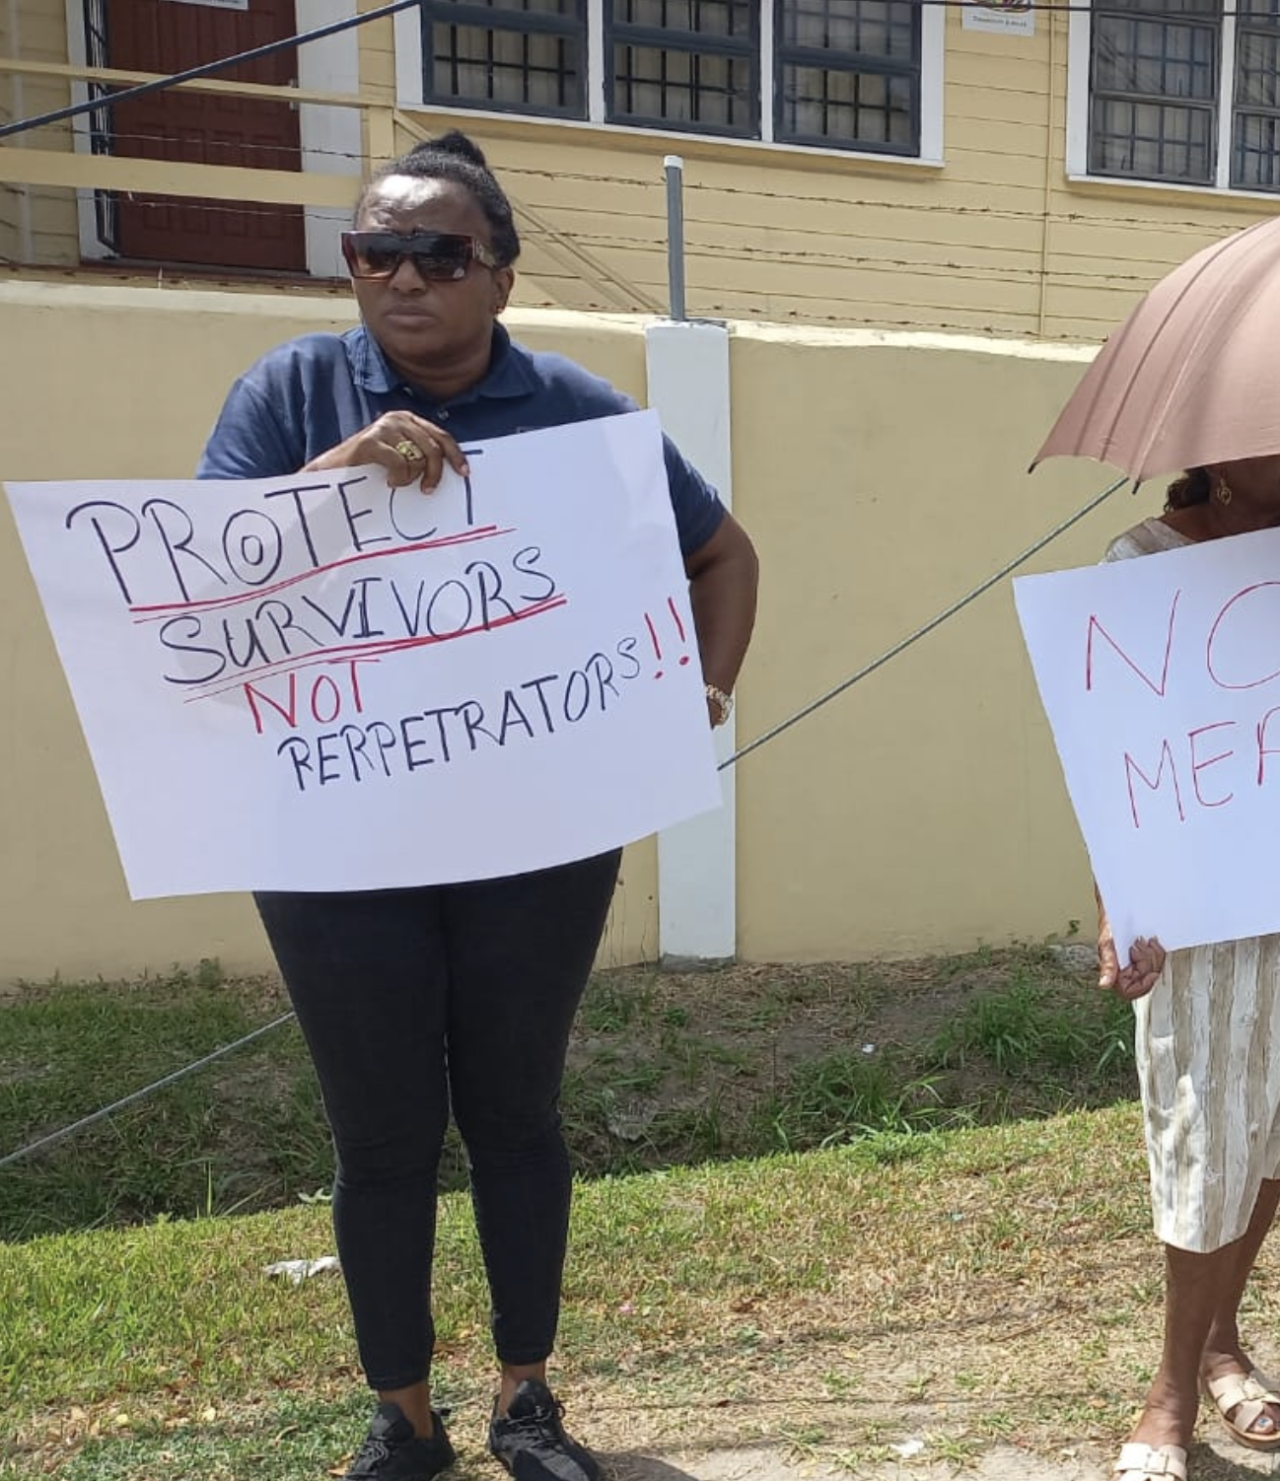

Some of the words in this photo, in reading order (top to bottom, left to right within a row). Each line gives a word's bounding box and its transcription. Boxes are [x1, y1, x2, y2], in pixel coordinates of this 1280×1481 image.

[65, 448, 484, 604] PROTECT
[159, 546, 557, 684] SURVIVORS
[244, 658, 380, 734] NOT
